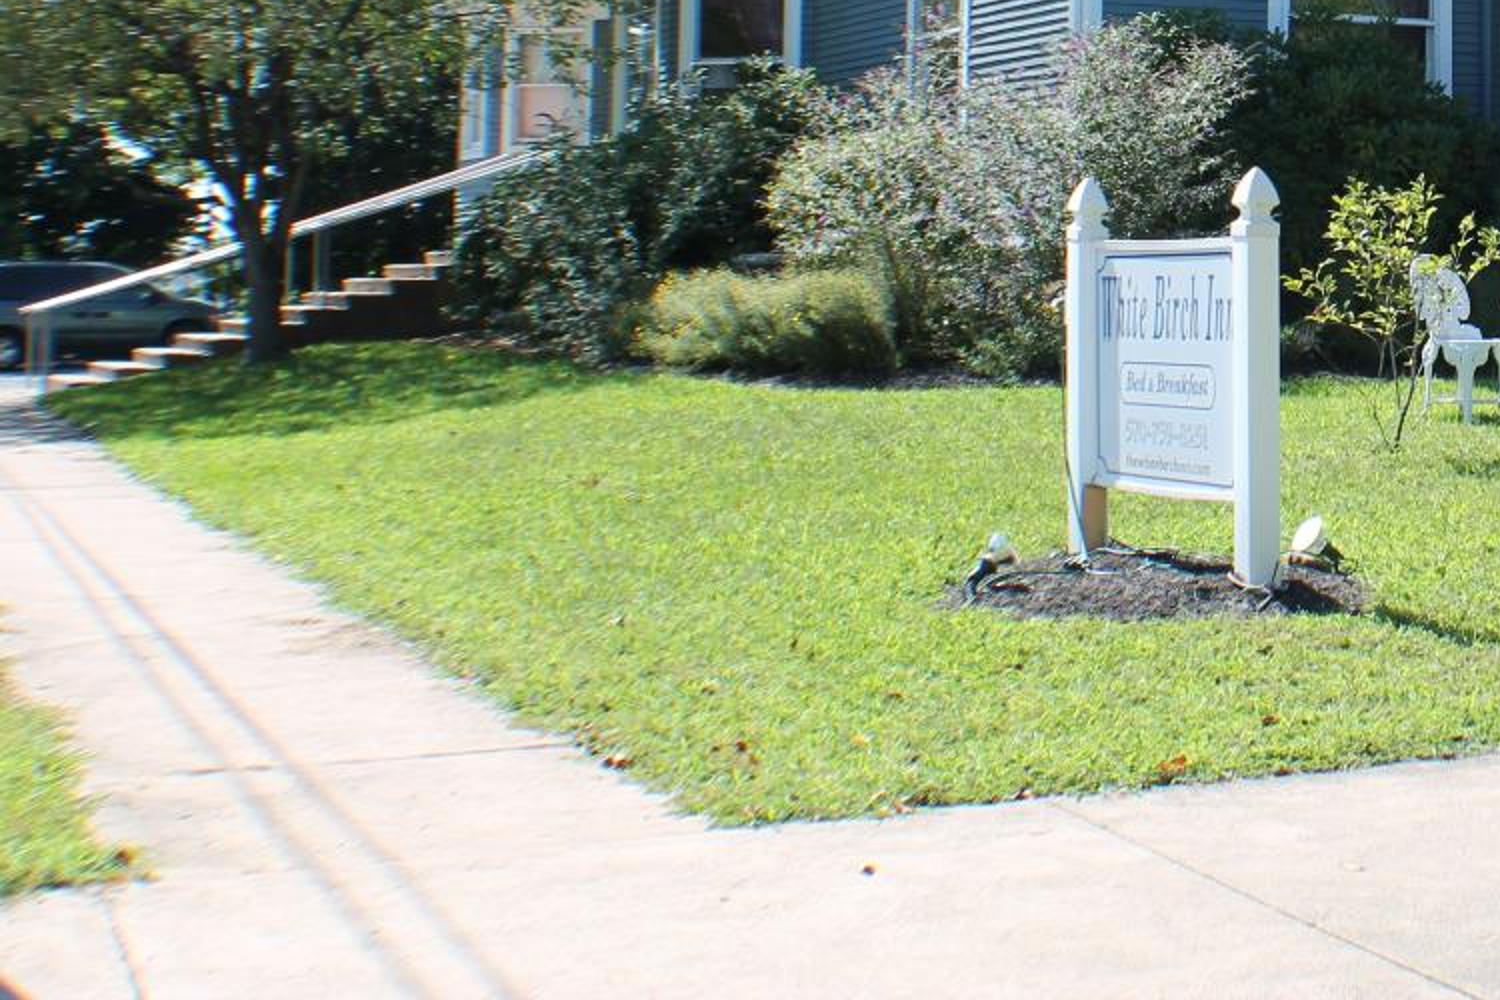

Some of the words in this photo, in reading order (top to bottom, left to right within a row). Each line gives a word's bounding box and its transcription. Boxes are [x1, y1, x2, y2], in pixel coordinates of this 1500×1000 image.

[1101, 275, 1147, 339] White
[1152, 275, 1199, 341] Birch
[1126, 370, 1146, 393] Bed
[1156, 372, 1209, 402] Breakfast
